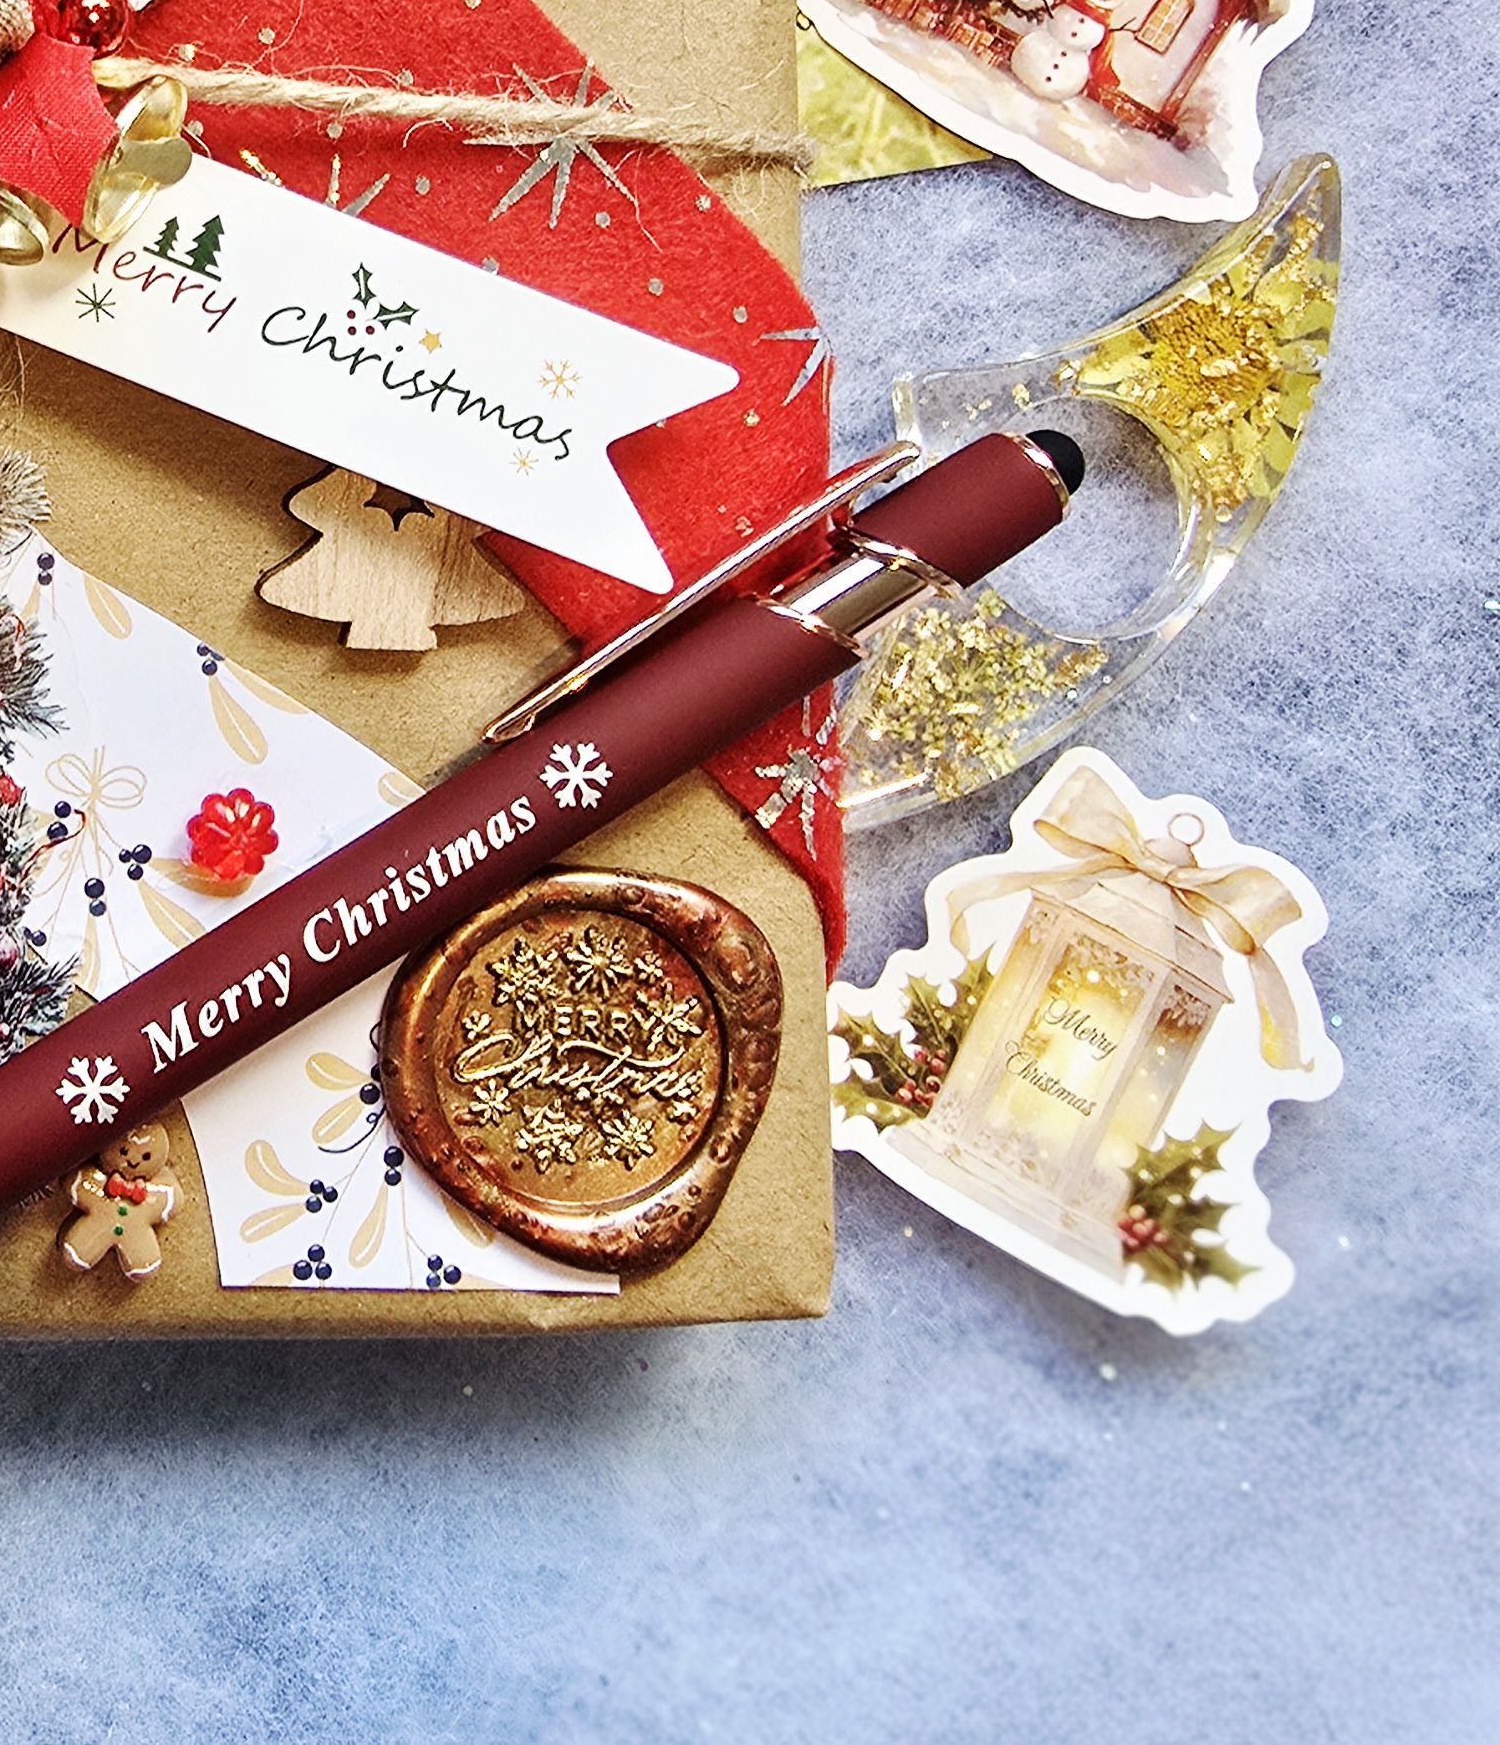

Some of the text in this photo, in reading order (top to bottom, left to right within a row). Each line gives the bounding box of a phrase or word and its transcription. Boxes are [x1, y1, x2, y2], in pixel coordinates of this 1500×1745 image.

[52, 225, 575, 461] Merry Christmas
[140, 792, 537, 1074] Merry Christmas
[1004, 1040, 1098, 1119] Christmas
[1043, 996, 1120, 1061] Merry
